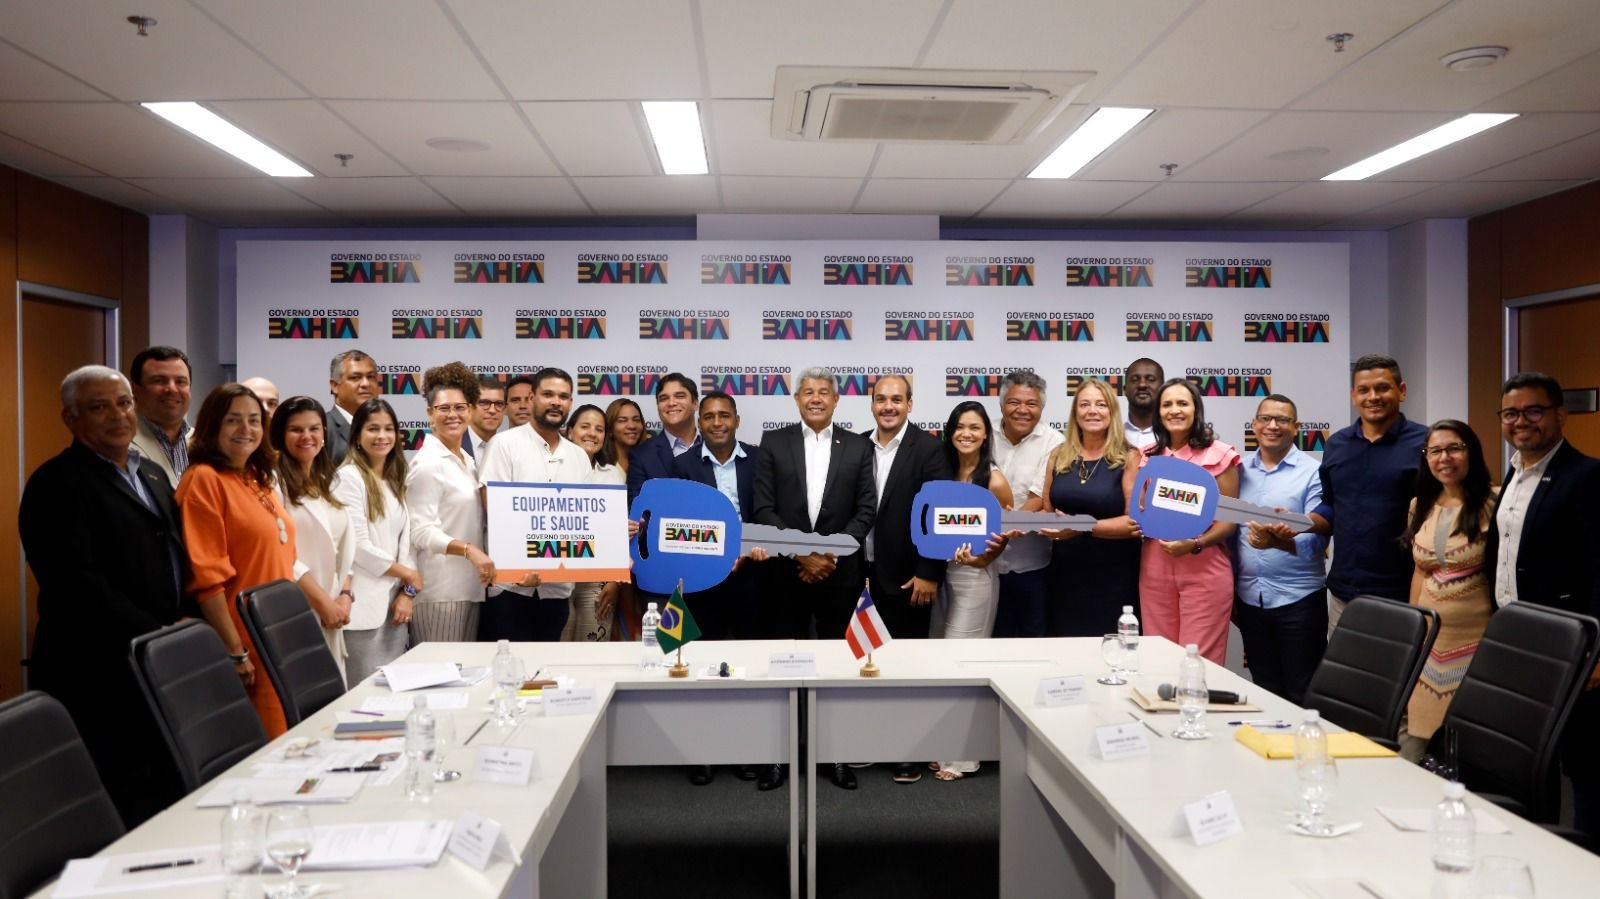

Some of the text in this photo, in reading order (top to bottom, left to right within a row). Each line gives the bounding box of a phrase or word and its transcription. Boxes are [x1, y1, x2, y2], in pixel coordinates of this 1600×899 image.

[946, 376, 1003, 396] BAH
[512, 497, 606, 513] EQUIPAMENTOS
[531, 514, 589, 531] DE SAÚDE
